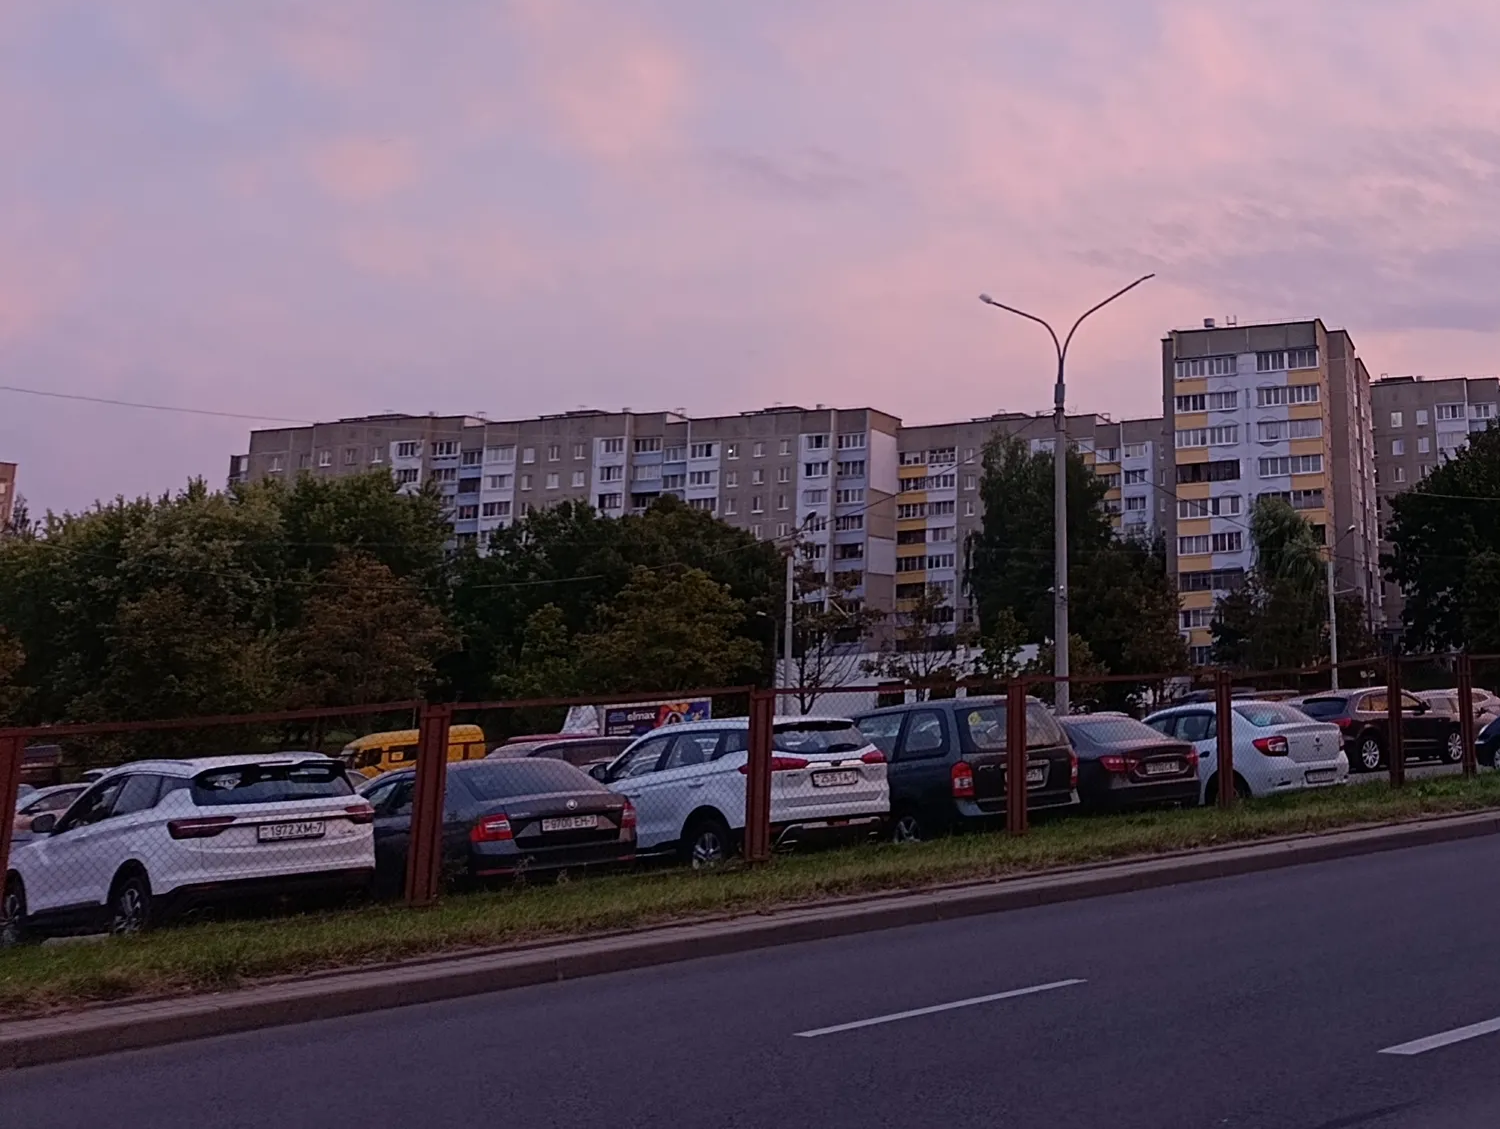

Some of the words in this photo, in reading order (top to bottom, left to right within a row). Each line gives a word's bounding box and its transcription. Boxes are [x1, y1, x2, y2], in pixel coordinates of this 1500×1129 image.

[627, 711, 657, 722] elmax
[270, 824, 294, 836] 1972
[297, 822, 323, 834] XM-7
